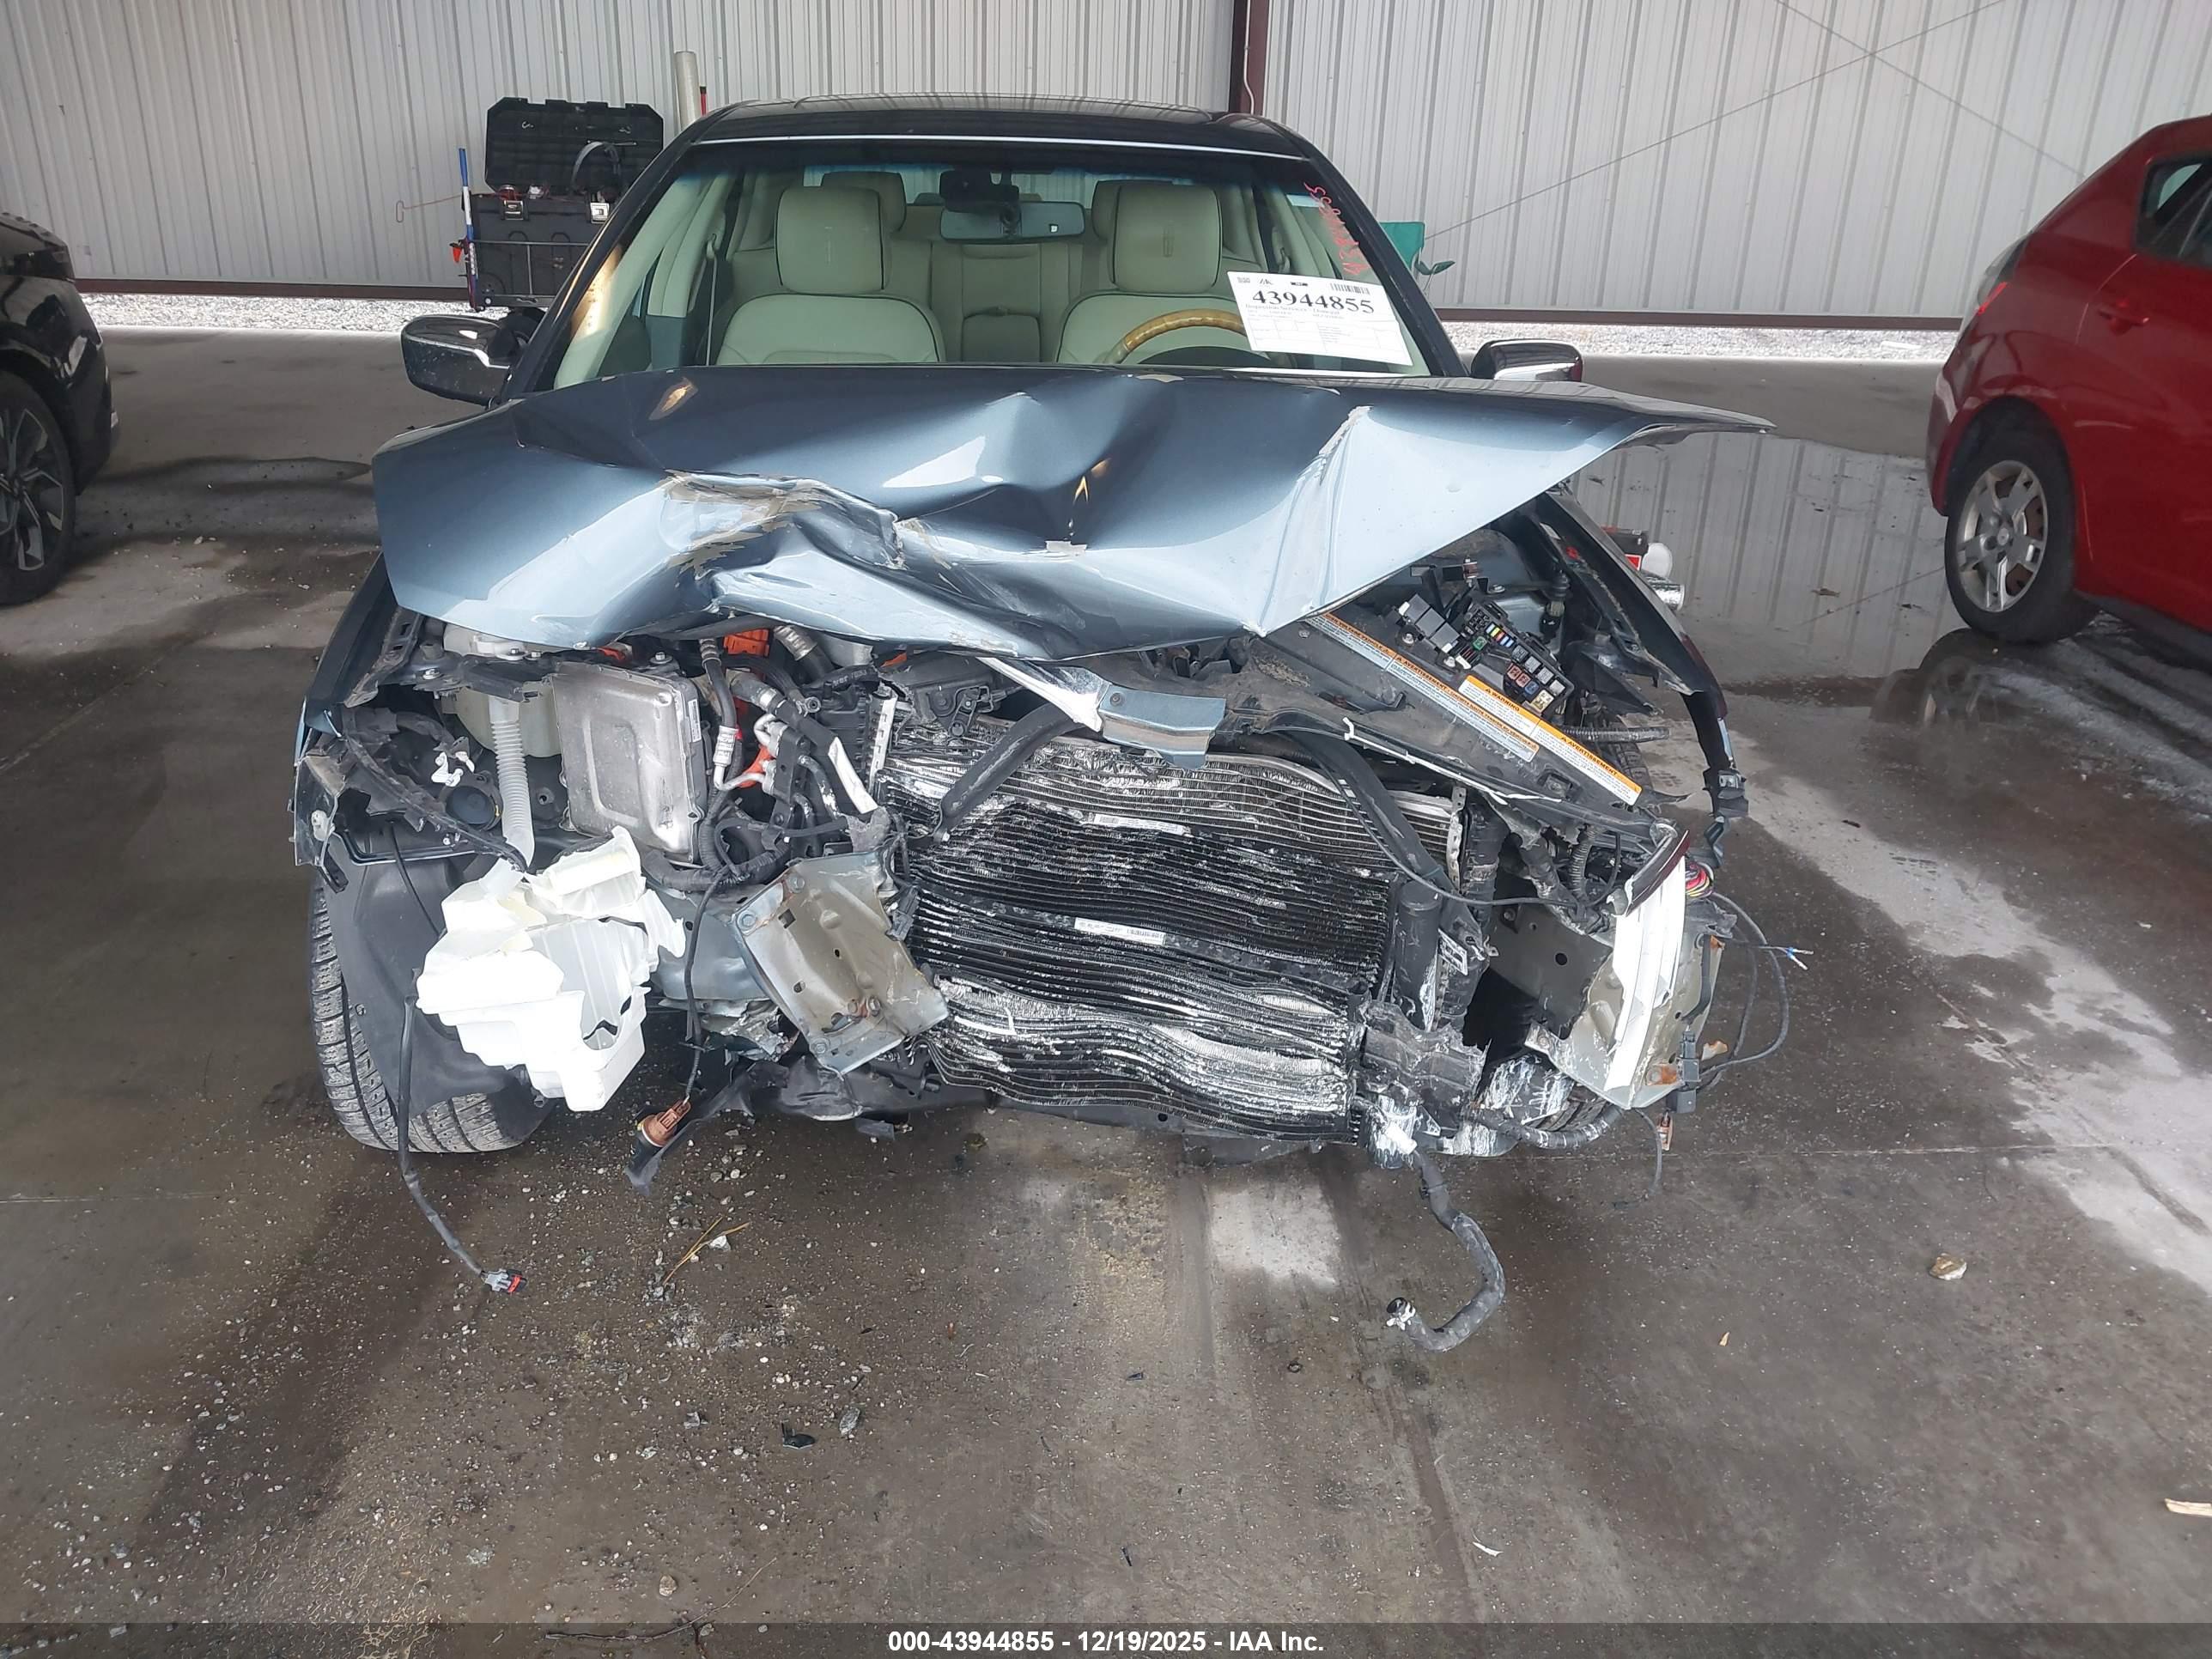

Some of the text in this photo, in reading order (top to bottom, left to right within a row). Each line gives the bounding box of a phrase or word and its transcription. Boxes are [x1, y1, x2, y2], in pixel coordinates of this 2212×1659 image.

[1252, 290, 1374, 313] 43944855
[1492, 690, 1520, 713] WARNING
[1567, 740, 1618, 775] AVERTISSEMENT
